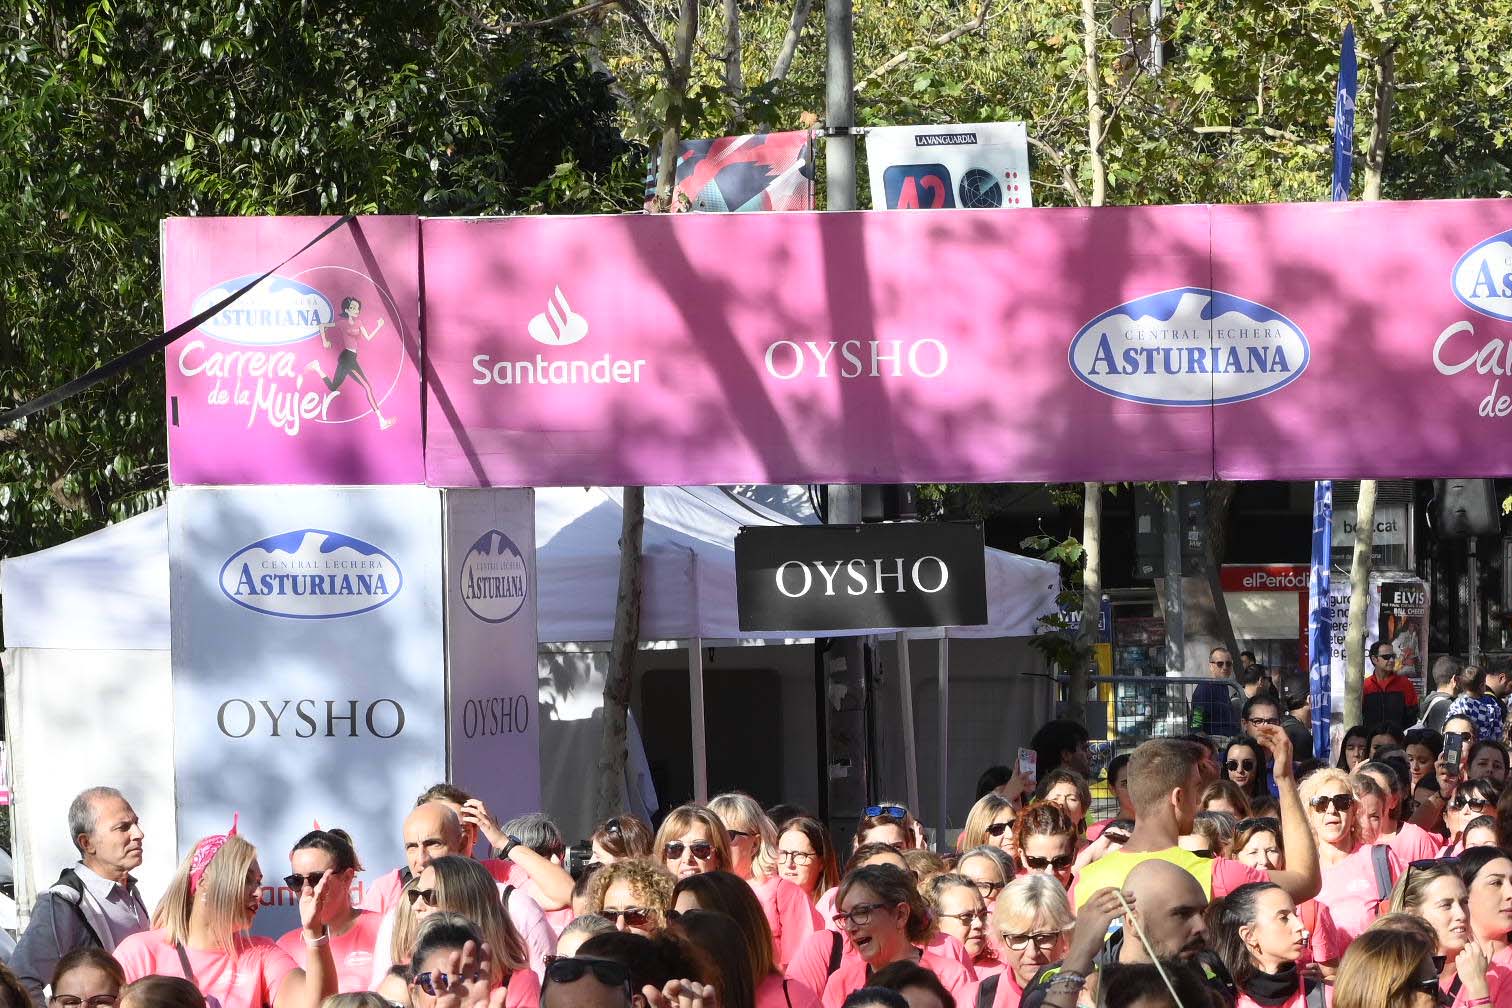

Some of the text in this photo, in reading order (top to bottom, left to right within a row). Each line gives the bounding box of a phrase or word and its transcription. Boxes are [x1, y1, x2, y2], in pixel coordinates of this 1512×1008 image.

[1125, 328, 1282, 341] CENTRAL LECHERA
[178, 341, 297, 377] Carrera
[472, 353, 646, 386] Santander
[764, 338, 949, 380] OYSHO
[1088, 332, 1291, 376] ASTURIANA
[207, 374, 341, 437] de la Mujer
[234, 562, 389, 596] ASTURIANA
[262, 560, 383, 569] CENTRAL LECHERA
[466, 563, 524, 600] ASTURIANA
[775, 555, 949, 598] OYSHO
[1242, 572, 1311, 588] elPeriódi
[1393, 591, 1424, 604] ELVIS
[217, 698, 405, 739] OYSHO
[463, 694, 529, 739] OYSHO
